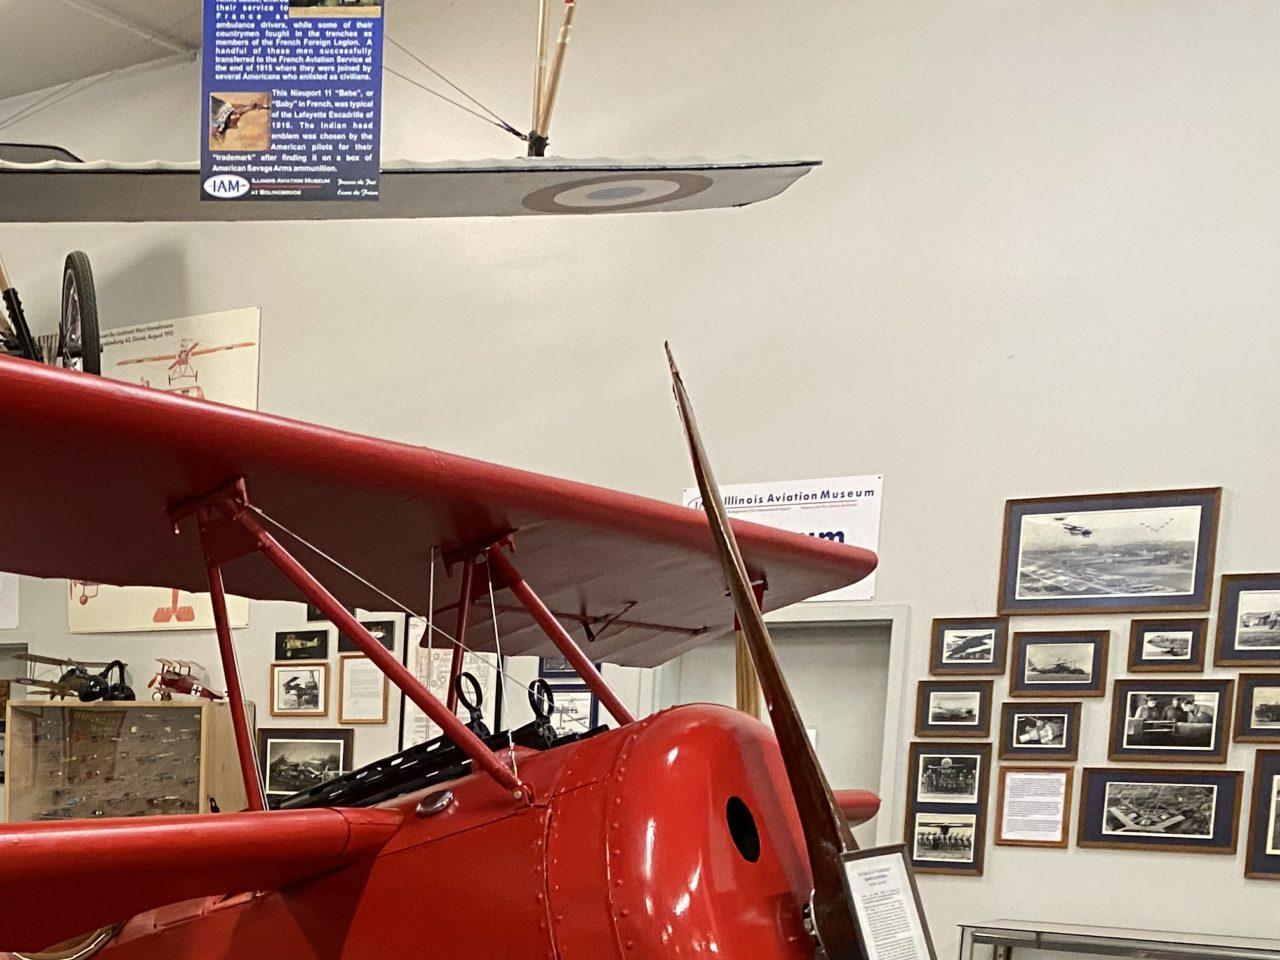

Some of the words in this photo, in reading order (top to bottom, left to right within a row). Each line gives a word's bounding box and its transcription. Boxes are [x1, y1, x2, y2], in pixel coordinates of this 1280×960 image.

[213, 181, 240, 192] IAM
[724, 494, 763, 506] Illinois
[767, 492, 818, 503] Aviation
[820, 489, 874, 500] Museum
